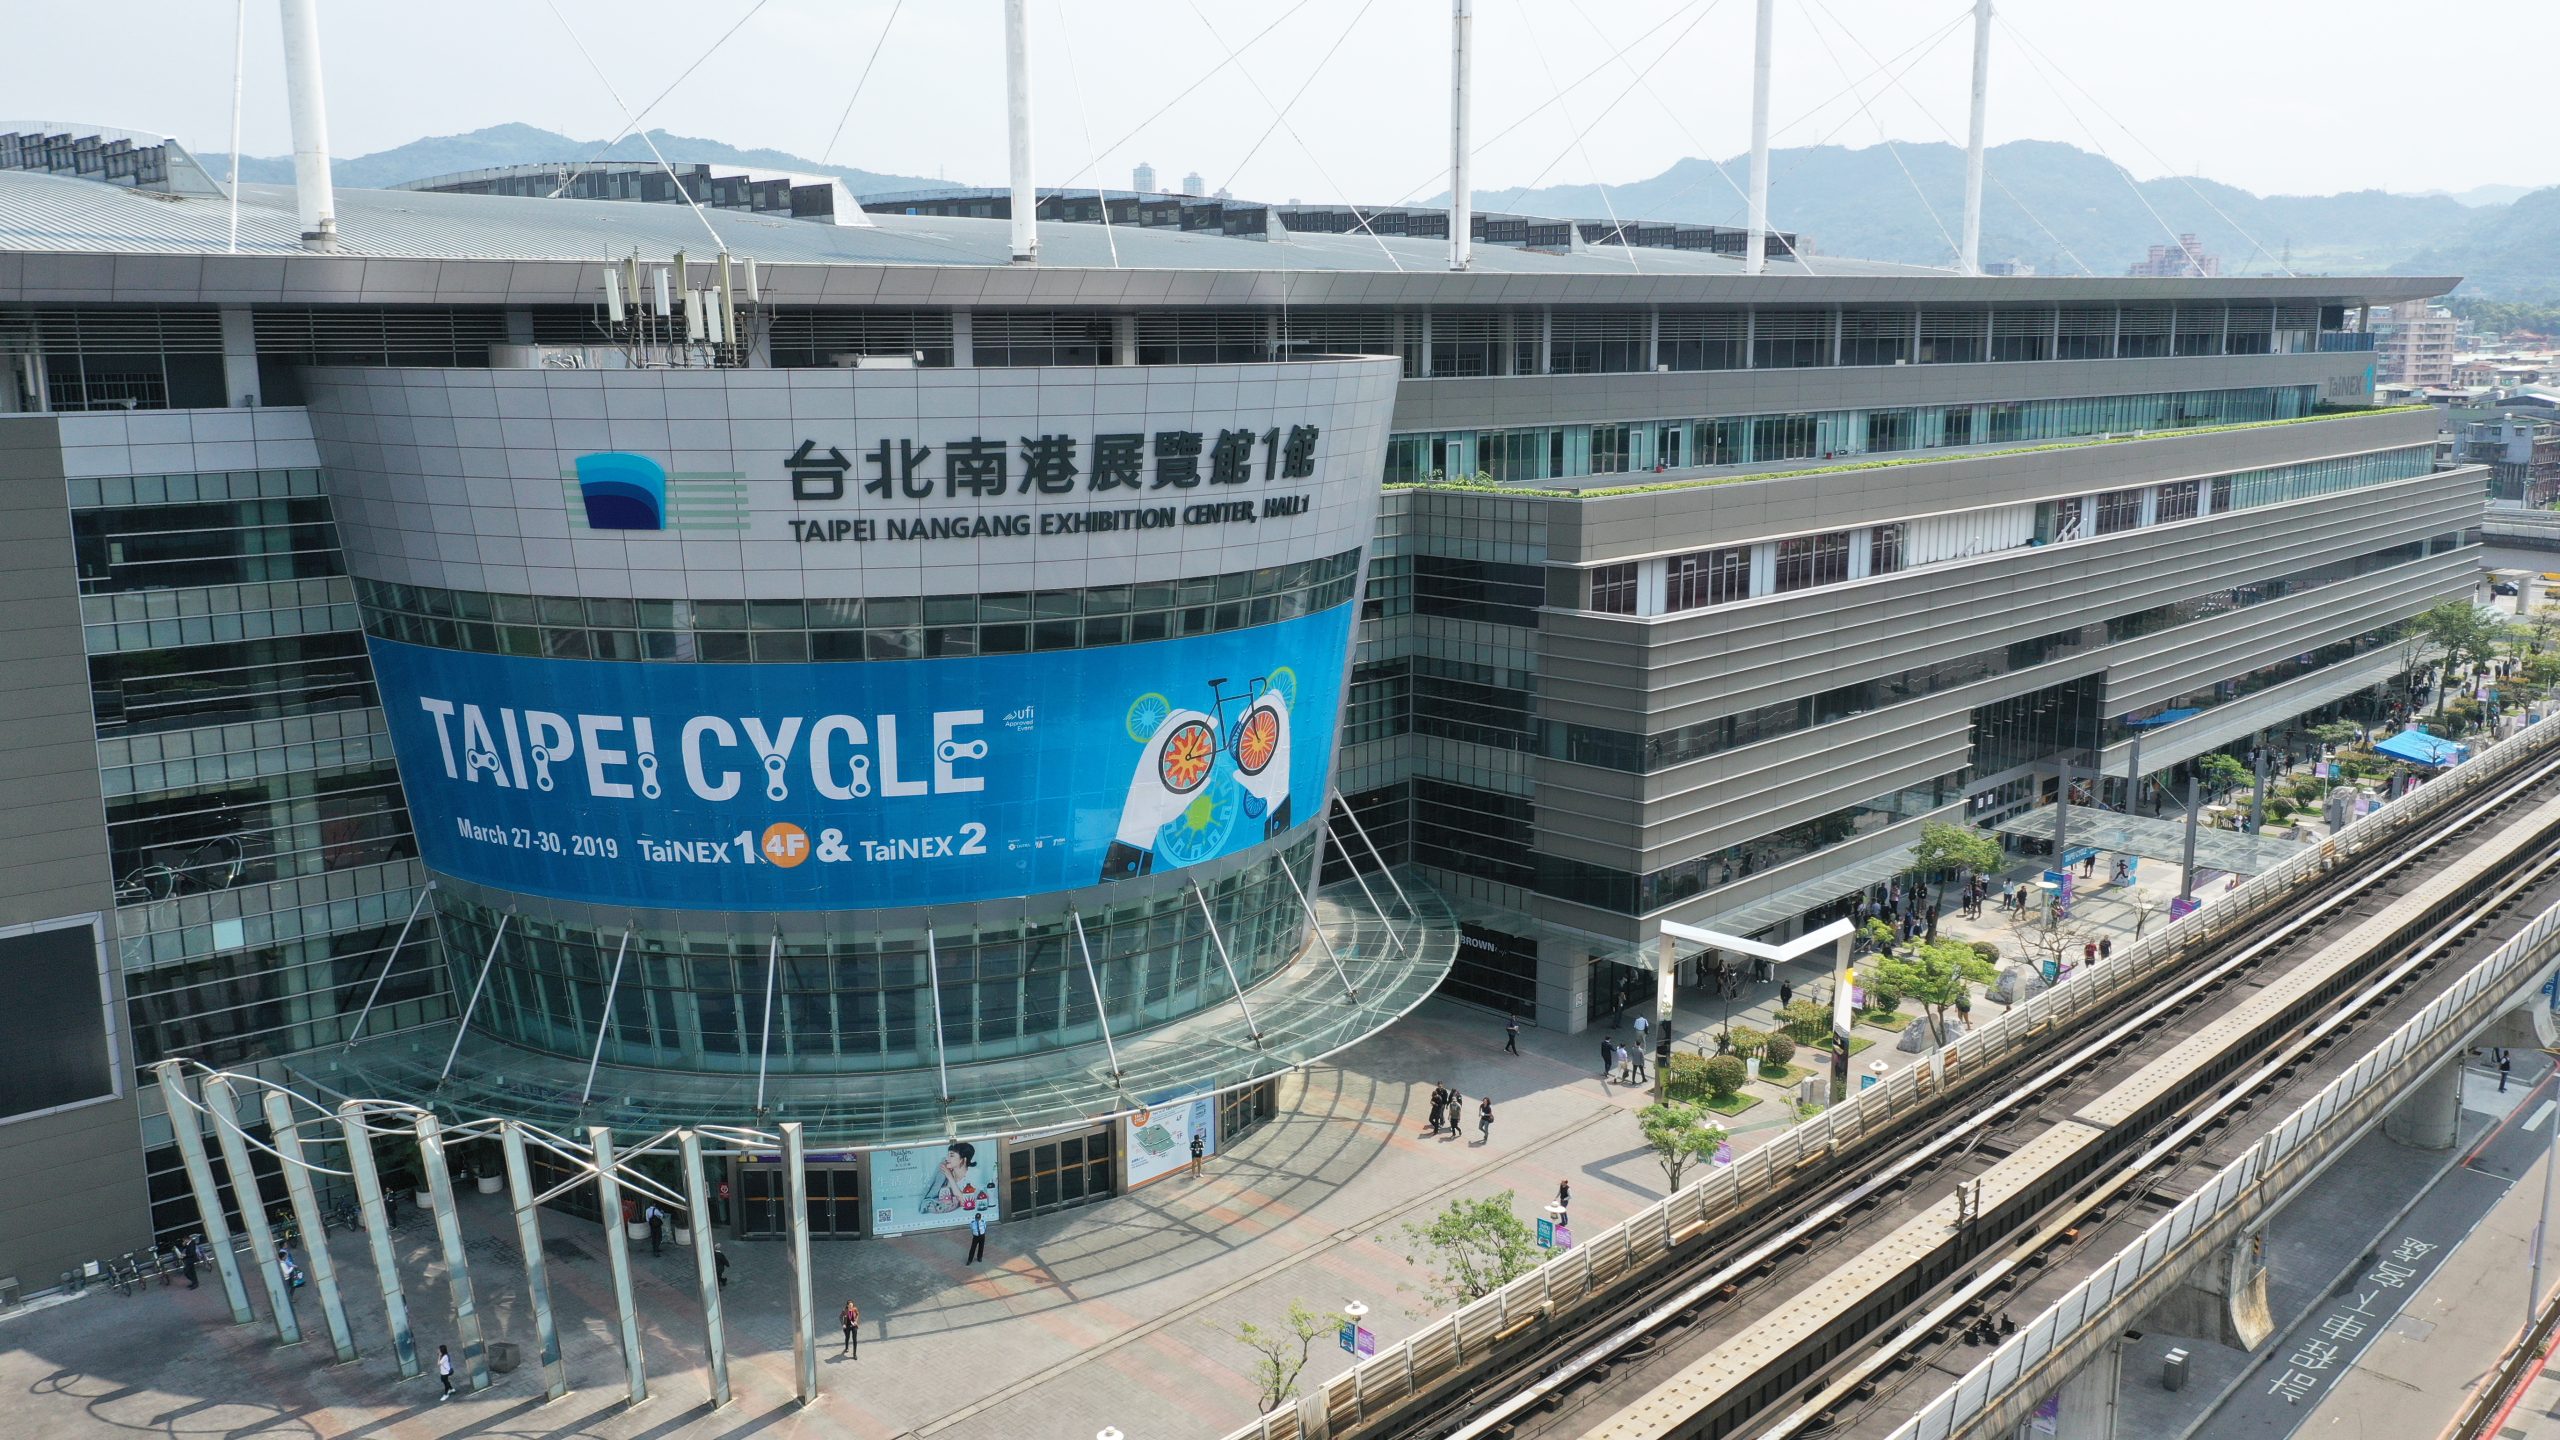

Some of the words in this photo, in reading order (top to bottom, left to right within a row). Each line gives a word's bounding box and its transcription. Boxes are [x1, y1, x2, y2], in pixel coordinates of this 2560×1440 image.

[783, 425, 1320, 500] 台北南港展覽館1館
[788, 518, 876, 543] TAIPEI
[887, 514, 1031, 541] NANGANG
[1040, 507, 1176, 536] EXHIBITION
[1183, 500, 1257, 526] CENTER,
[1005, 719, 1034, 728] Approved
[1017, 705, 1034, 720] ufi
[419, 695, 662, 801] TAIPEI
[681, 708, 988, 803] CYCLE
[456, 816, 508, 846] March
[511, 827, 567, 857] 27-30,
[571, 835, 619, 859] 2019
[637, 839, 731, 863] TaiNEX
[766, 832, 806, 858] 4F
[816, 828, 852, 864] &
[859, 835, 954, 862] TaiNEX
[958, 821, 987, 856] 2
[1461, 935, 1495, 952] BROWN
